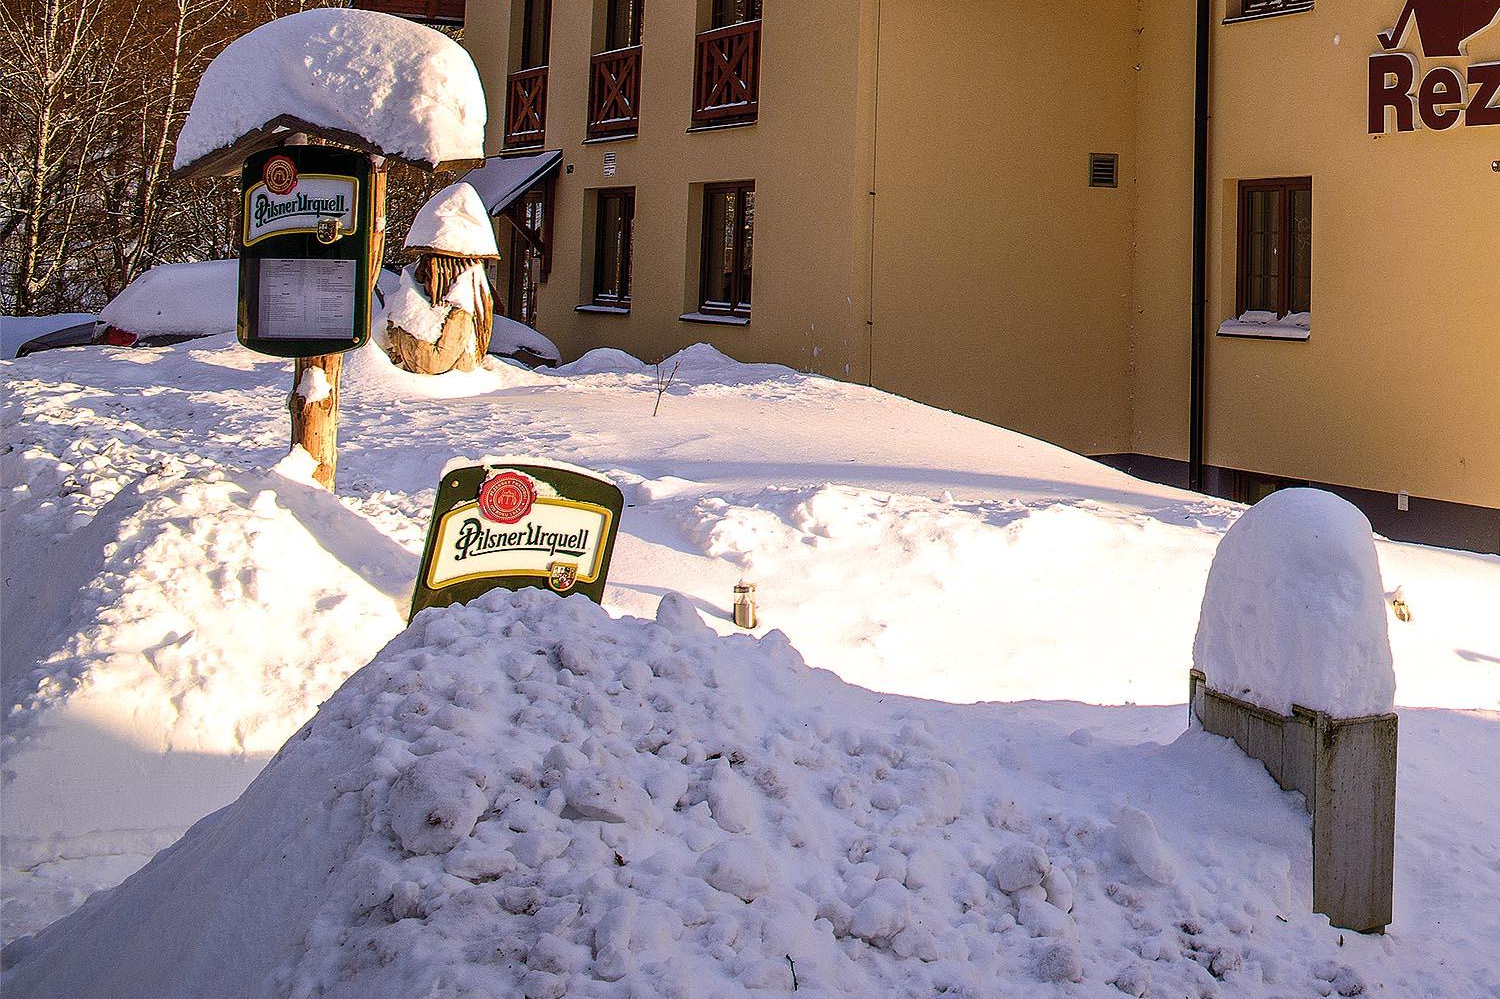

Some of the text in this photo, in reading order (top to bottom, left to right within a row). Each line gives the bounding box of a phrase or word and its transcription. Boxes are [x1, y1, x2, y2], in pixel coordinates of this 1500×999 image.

[254, 194, 298, 228] Pilsner
[455, 518, 589, 561] Pilsner Urquell
